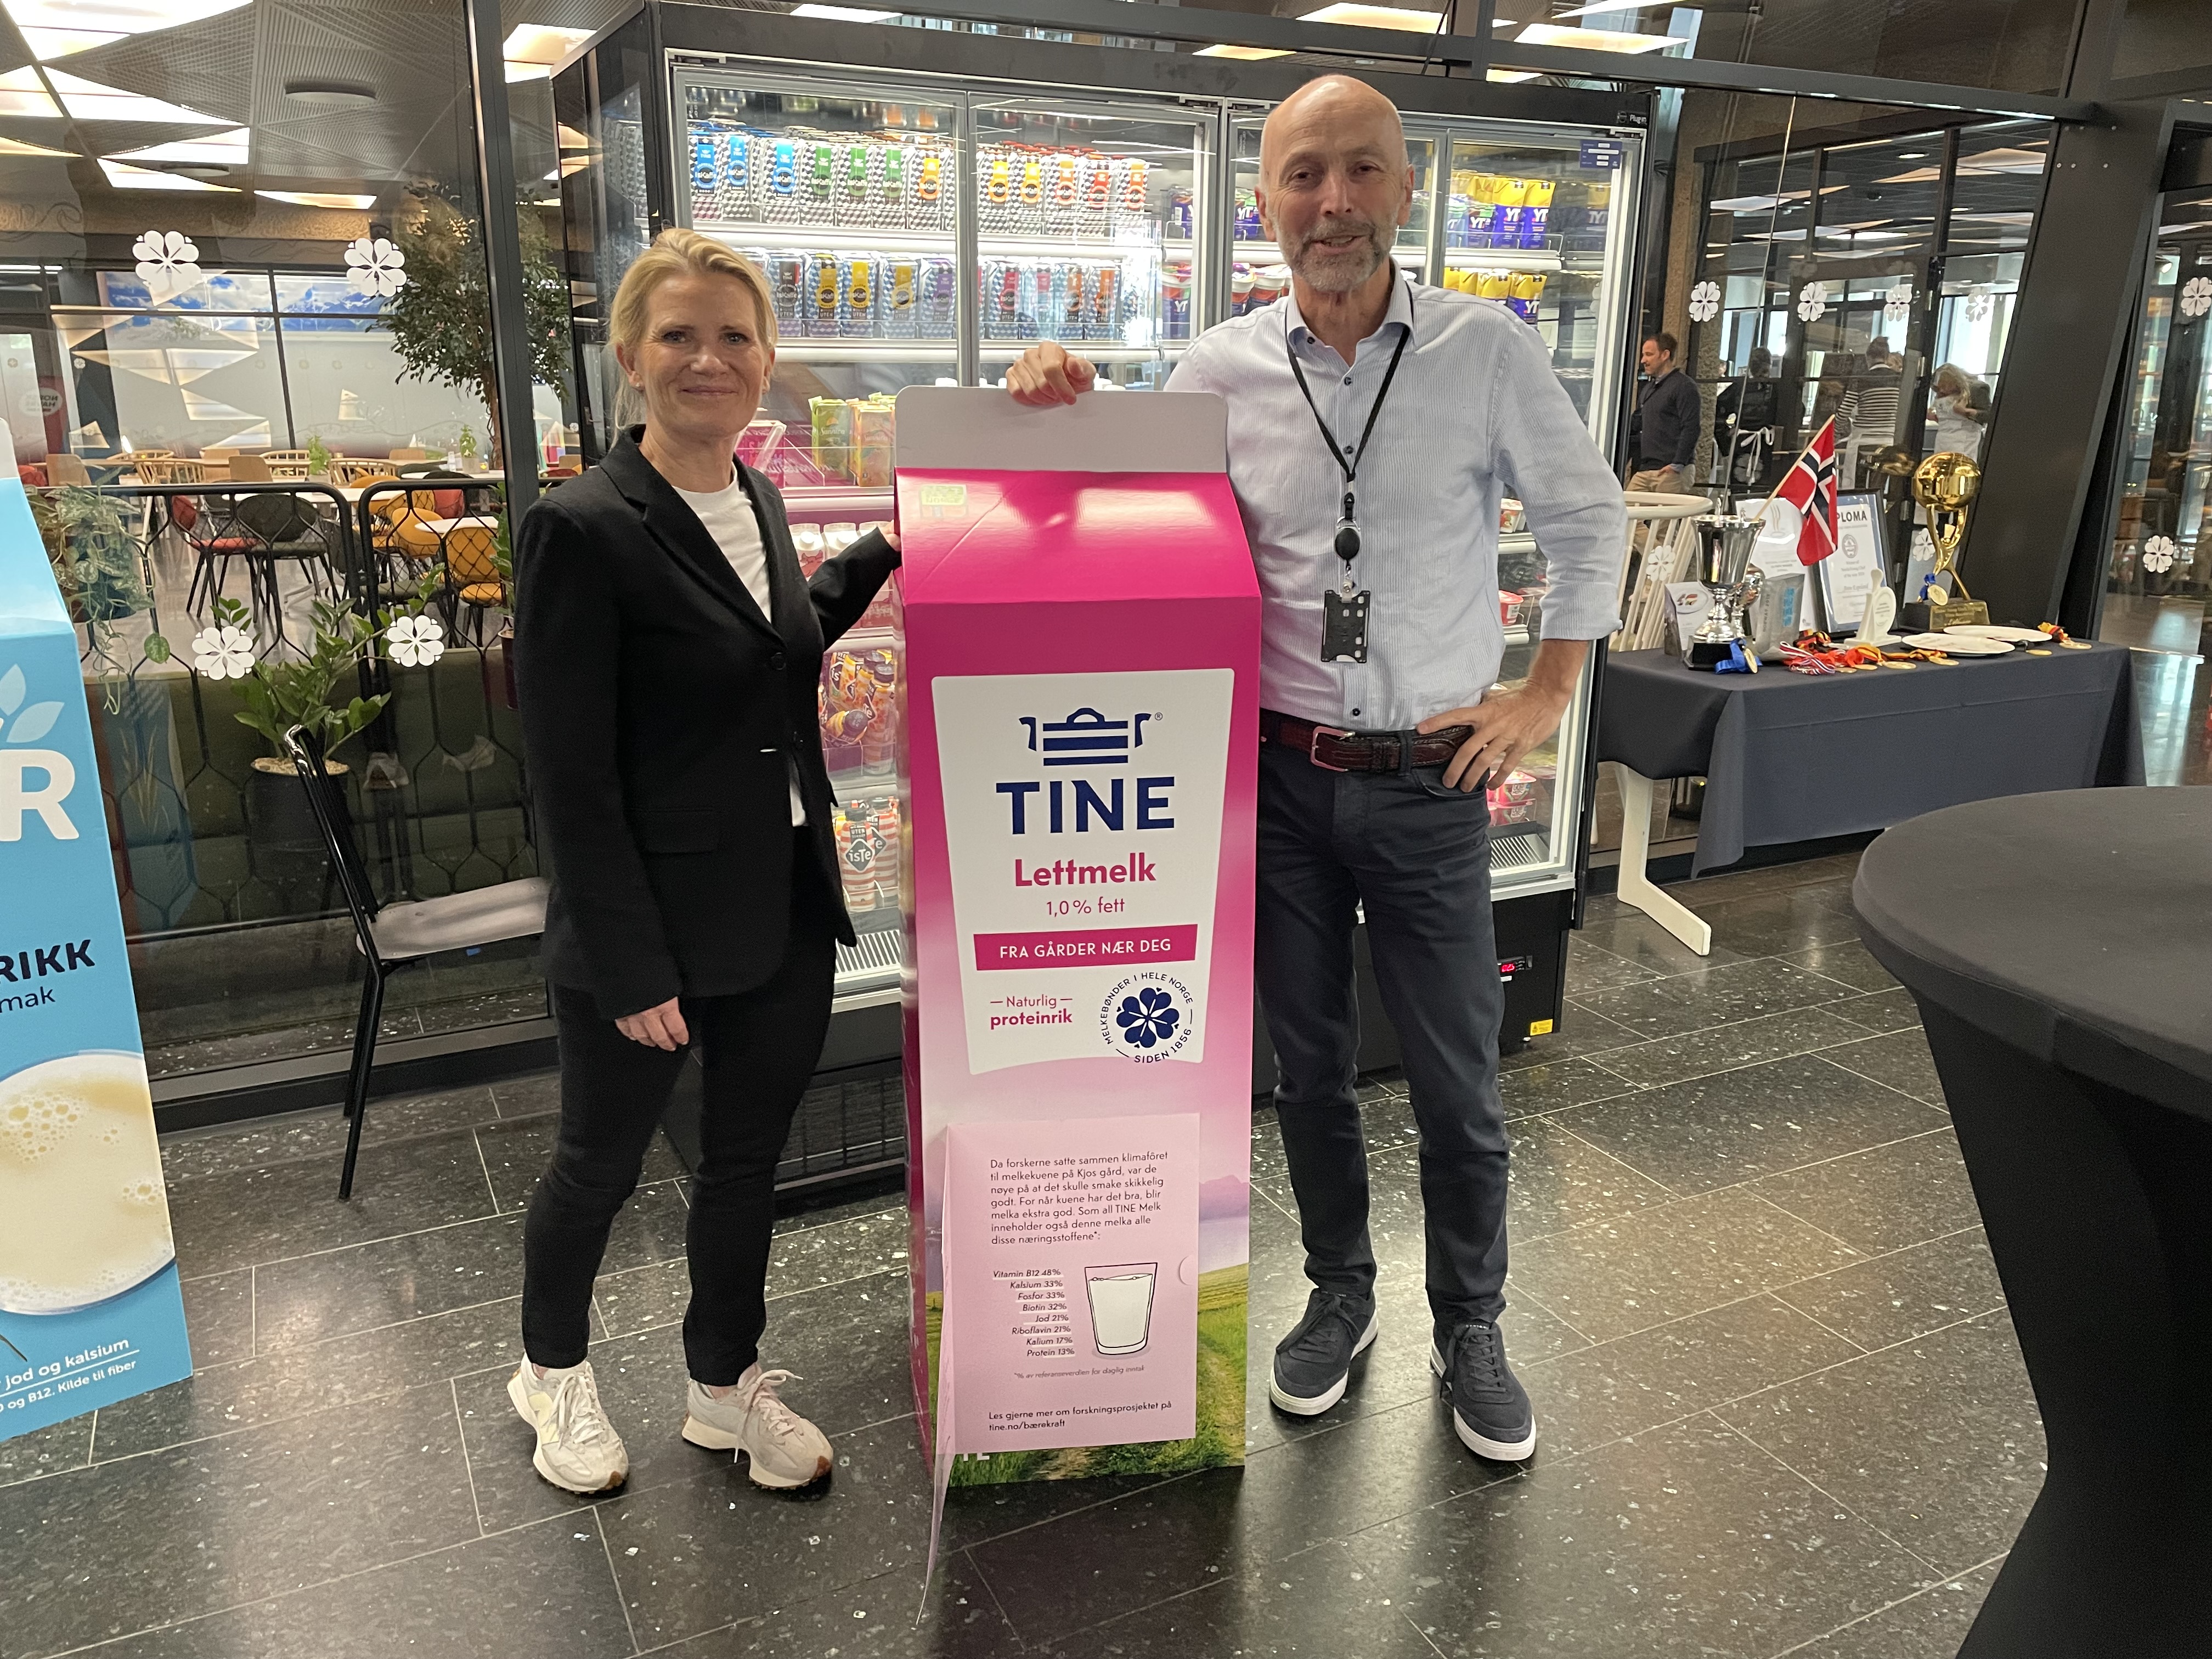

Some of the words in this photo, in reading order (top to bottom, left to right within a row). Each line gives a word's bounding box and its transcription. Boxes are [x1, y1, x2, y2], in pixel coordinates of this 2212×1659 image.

[1506, 208, 1521, 222] YT
[1534, 209, 1549, 222] YT
[1836, 511, 1867, 522] PLOMA
[996, 776, 1175, 834] TINE
[849, 849, 871, 862] isTe
[1015, 853, 1156, 887] Lettmelk
[1098, 896, 1125, 913] fett
[1000, 945, 1029, 958] FRA
[1034, 941, 1096, 957] GÅRDER
[1101, 941, 1137, 955] NÆR
[1141, 938, 1171, 953] DEG
[1006, 995, 1057, 1012] Naturlig
[1101, 979, 1131, 1044] MELKEBØNDER
[1142, 972, 1167, 981] HELE
[1169, 978, 1193, 1003] NORGE
[990, 1011, 1073, 1030] proteinrik
[1134, 1051, 1169, 1063] SIDEN
[1171, 1029, 1192, 1053] 1856
[991, 1160, 1003, 1168] Da
[1007, 1158, 1051, 1167] forskerne
[1002, 1171, 1059, 1180] melkekuene
[1063, 1170, 1074, 1180] på
[1077, 1169, 1096, 1179] Kjos
[1145, 1165, 1156, 1173] de
[991, 1187, 1014, 1195] nøye
[1018, 1184, 1029, 1195] på
[1045, 1183, 1059, 1192] det
[1063, 1181, 1088, 1191] skulle
[1092, 1180, 1121, 1189] smake
[1125, 1177, 1163, 1187] skikkelig
[1020, 1197, 1035, 1205] For
[1039, 1196, 1053, 1205] når
[1057, 1194, 1085, 1203] kuene
[1088, 1194, 1103, 1202] har
[1107, 1193, 1121, 1201] det
[1125, 1191, 1142, 1200] bra,
[1146, 1190, 1160, 1199] blir
[992, 1210, 1019, 1219] melka
[1023, 1209, 1049, 1218] ekstra
[1079, 1207, 1099, 1216] Som
[1103, 1205, 1113, 1214] all
[1115, 1204, 1136, 1213] TINE
[1139, 1202, 1161, 1211] Melk
[992, 1222, 1042, 1232] inneholder
[1046, 1221, 1068, 1231] også
[1072, 1220, 1101, 1228] denne
[1105, 1217, 1132, 1226] melka
[1135, 1215, 1151, 1224] alle
[992, 1235, 1015, 1244] disse
[5, 1368, 33, 1390] jod
[38, 1362, 60, 1375] og
[65, 1340, 129, 1368] kalsium
[1035, 1369, 1090, 1378] referanseverdien
[8, 1398, 25, 1408] og
[28, 1387, 55, 1403] B12.
[58, 1377, 89, 1392] Kilde
[93, 1369, 105, 1381] til
[108, 1361, 136, 1376] fiber
[1006, 1410, 1033, 1421] gjerne
[1073, 1402, 1158, 1414] forskningsprosjektet
[1161, 1401, 1171, 1410] på
[989, 1420, 1065, 1431] tine.no/bærekraft
